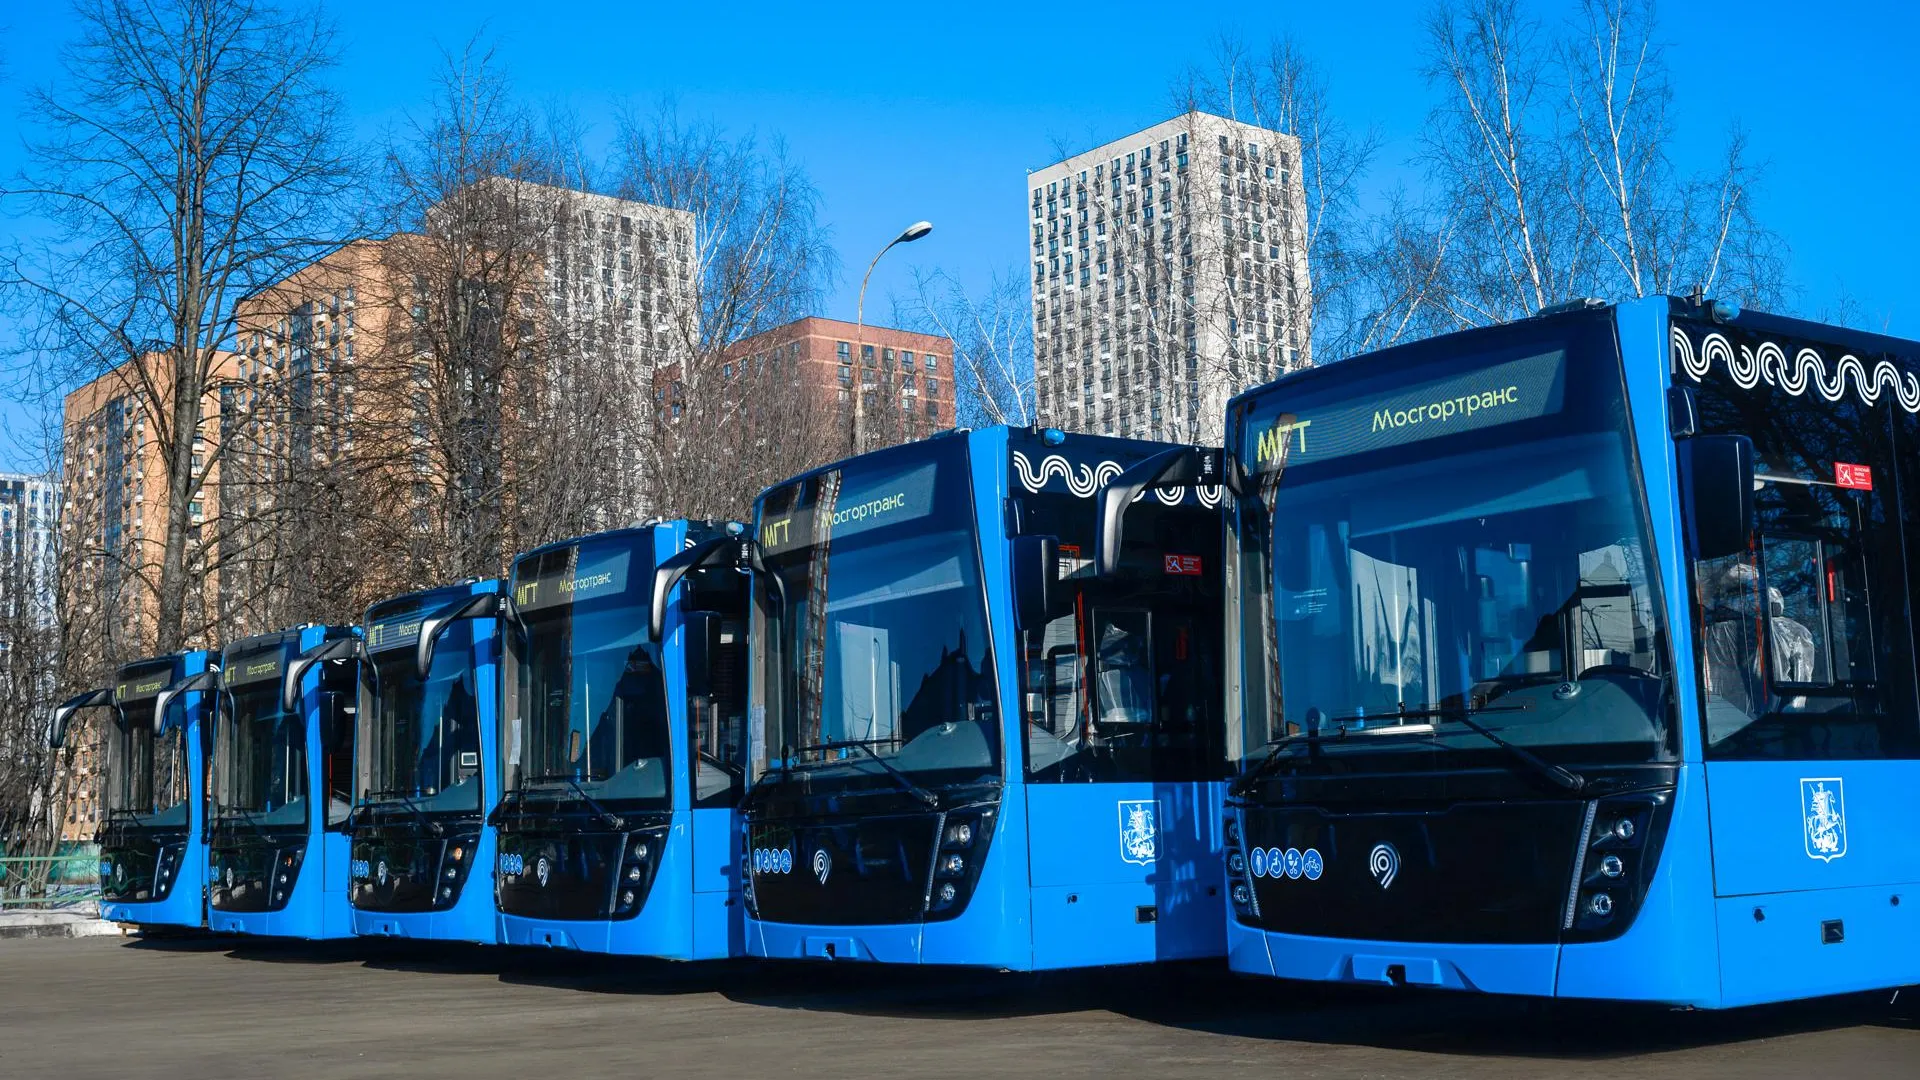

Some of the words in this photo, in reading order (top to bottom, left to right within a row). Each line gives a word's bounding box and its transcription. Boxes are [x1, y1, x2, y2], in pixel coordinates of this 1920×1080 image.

[1257, 420, 1312, 462] МГТ
[1372, 386, 1518, 433] Мосгортранс
[765, 519, 791, 548] МГТ
[821, 493, 905, 528] Мосгортранс
[517, 582, 538, 605] МГТ
[559, 572, 612, 594] Мосгортранс
